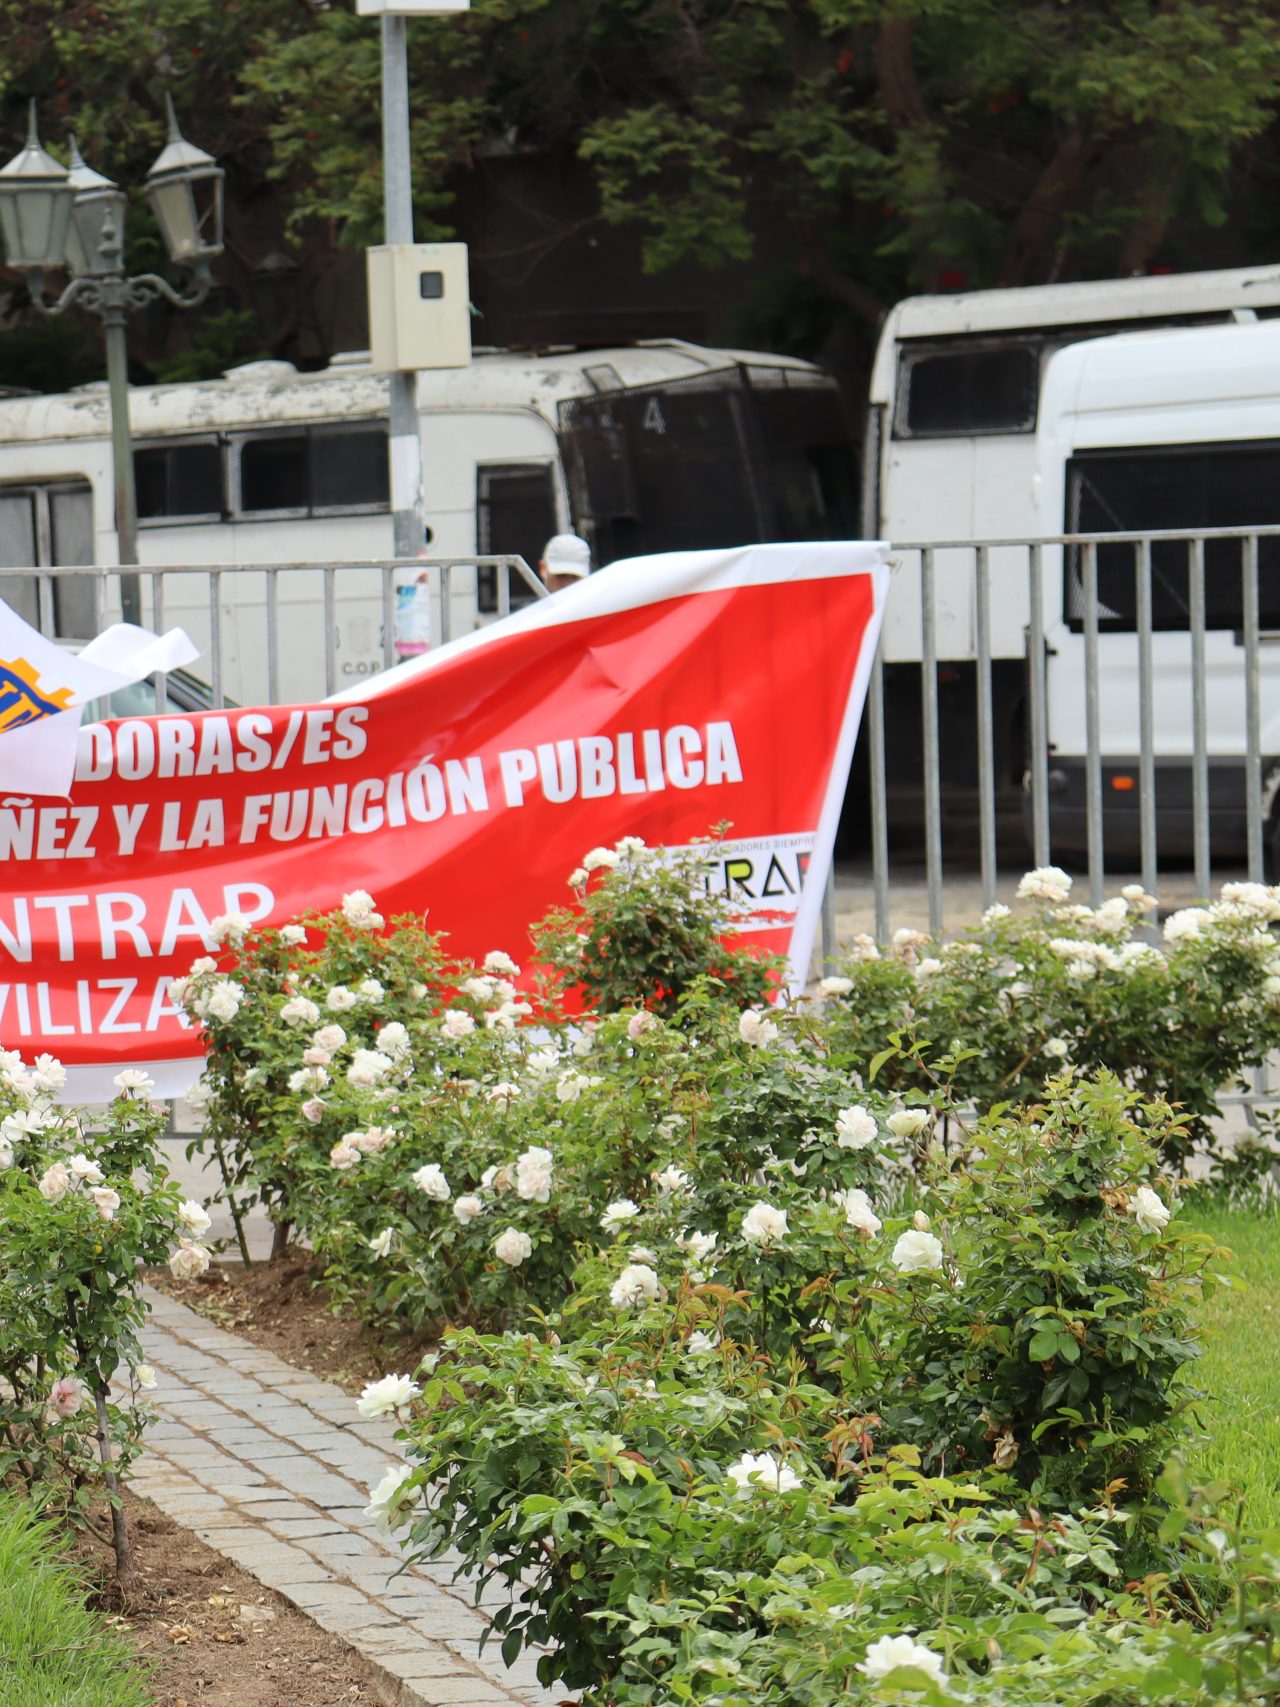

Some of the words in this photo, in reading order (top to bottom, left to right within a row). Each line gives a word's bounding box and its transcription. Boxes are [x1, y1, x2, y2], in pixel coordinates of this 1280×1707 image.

[74, 706, 369, 782] DORAS/ES
[112, 803, 149, 856] Y
[159, 798, 226, 853] LA
[239, 754, 489, 844] FUNCIÓN
[499, 720, 744, 808] PUBLICA
